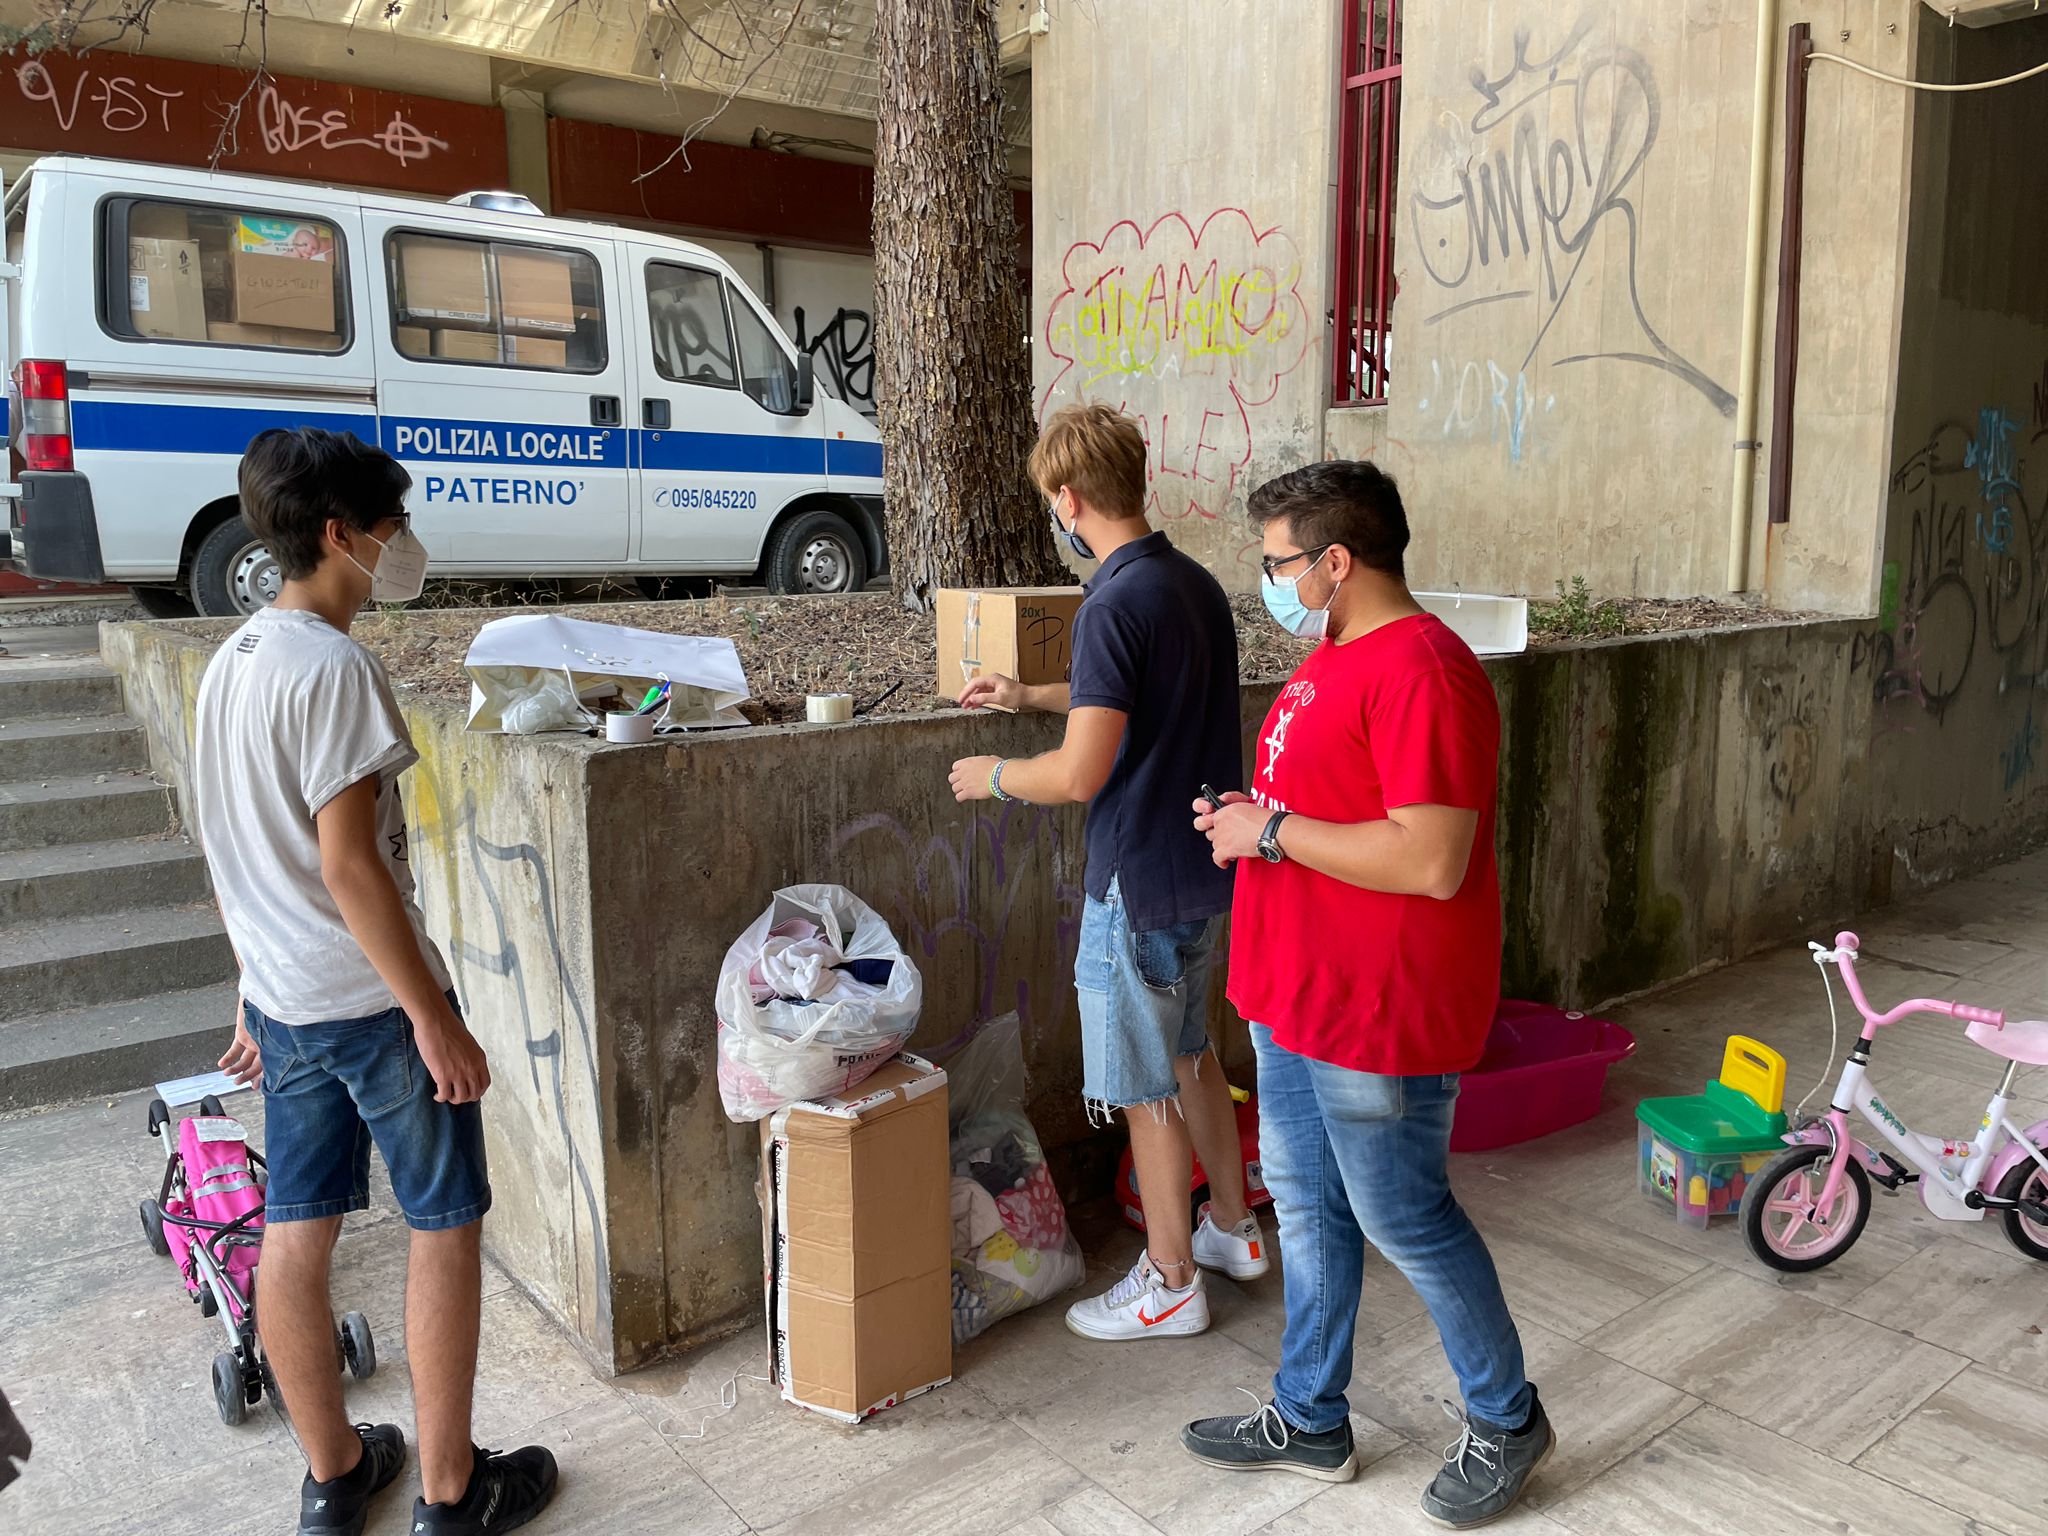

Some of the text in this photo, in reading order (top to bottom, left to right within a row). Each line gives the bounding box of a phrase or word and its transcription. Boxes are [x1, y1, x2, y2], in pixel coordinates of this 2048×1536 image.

[395, 426, 604, 461] POLIZIA LOCALE
[671, 488, 757, 510] 095/845220
